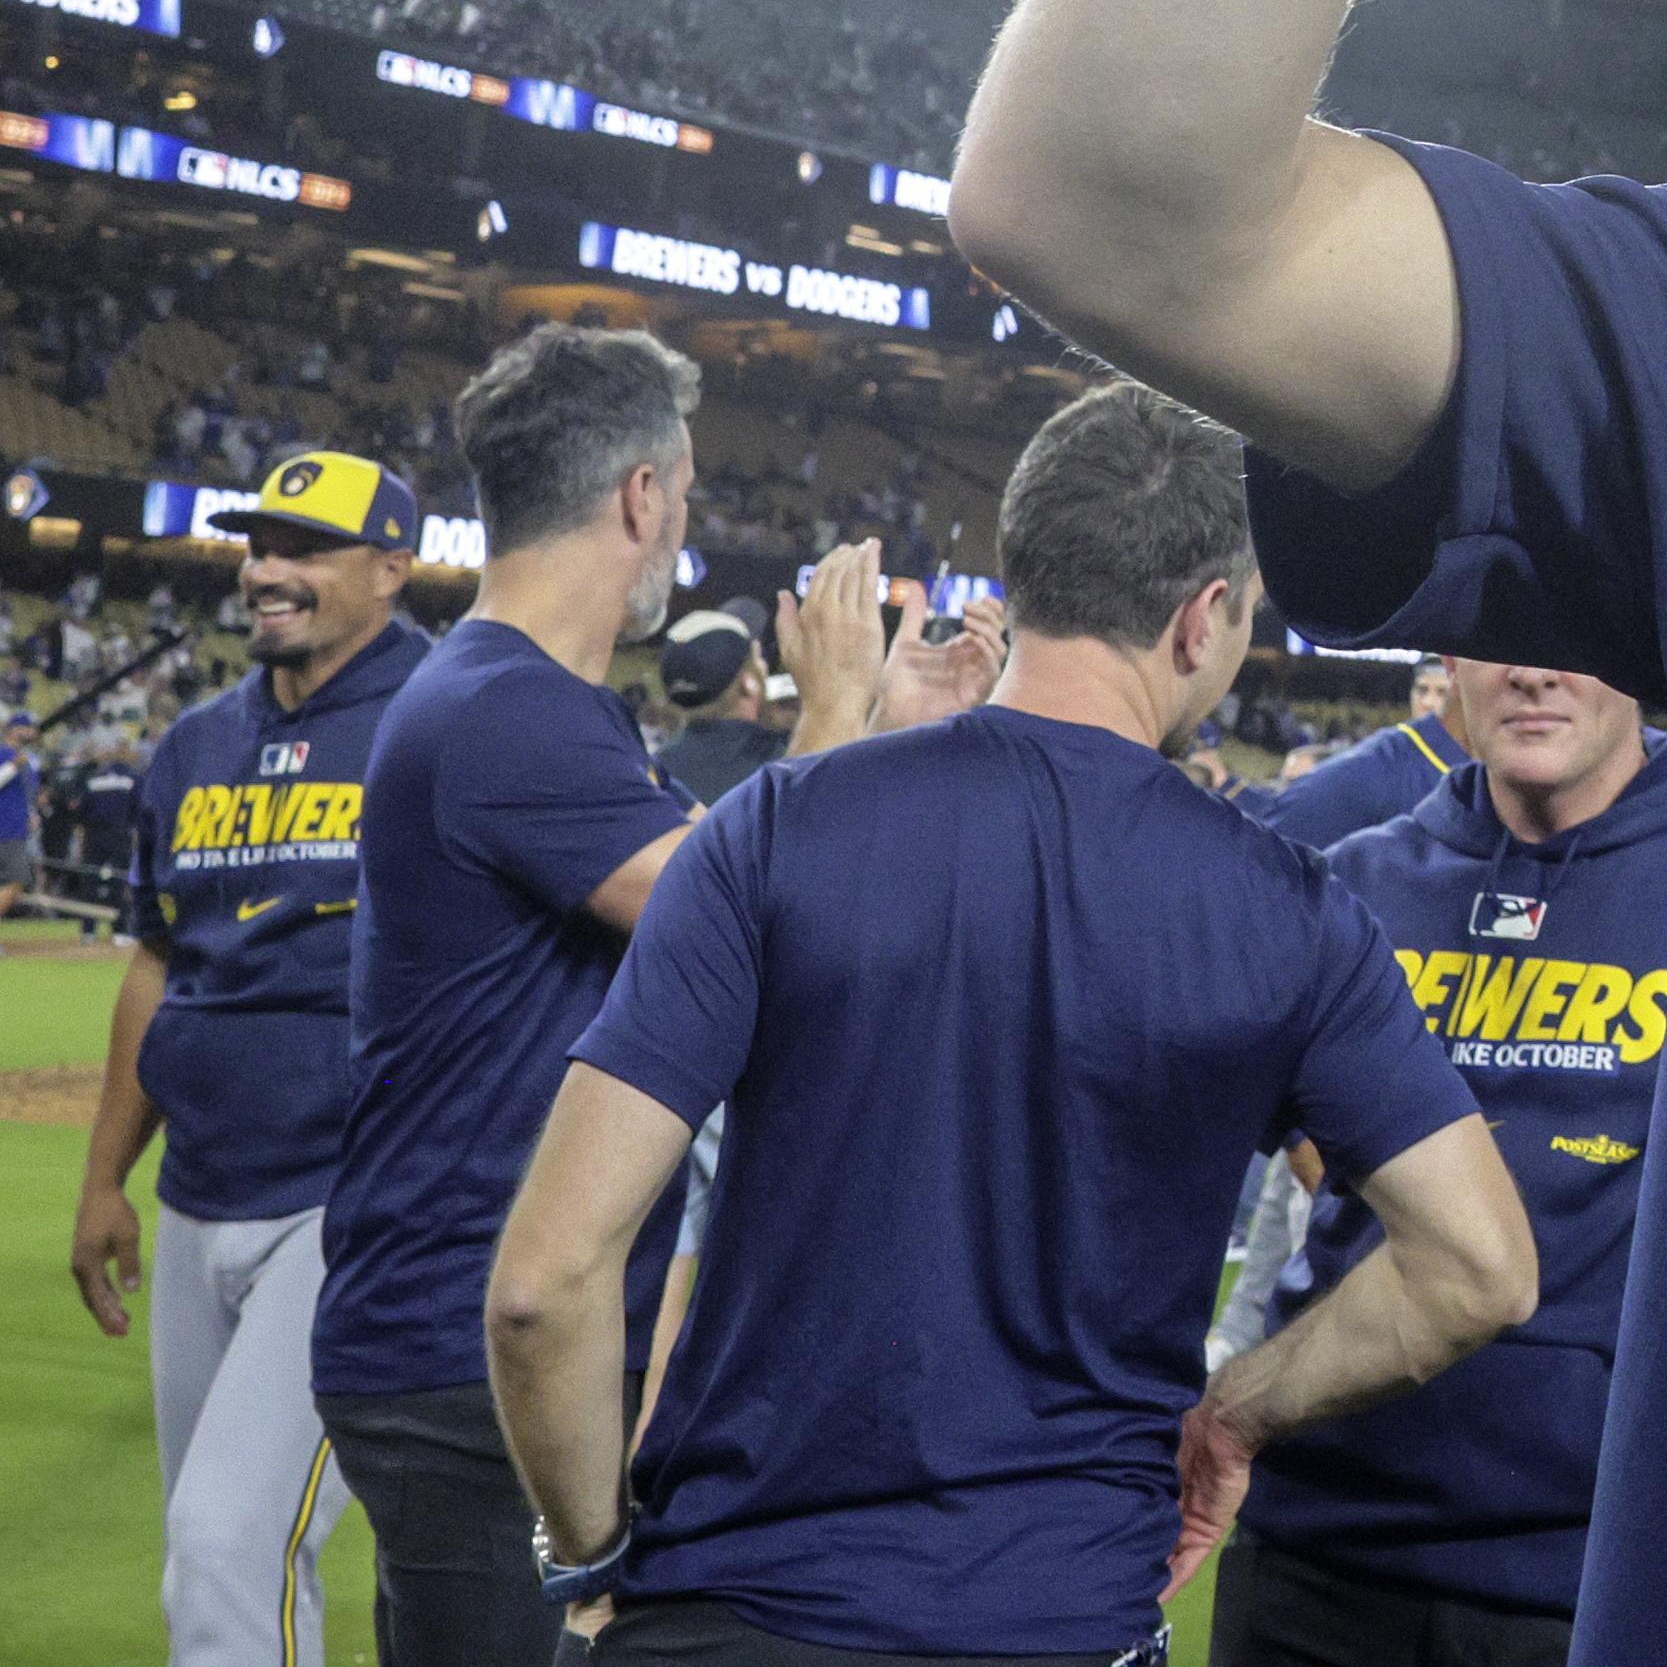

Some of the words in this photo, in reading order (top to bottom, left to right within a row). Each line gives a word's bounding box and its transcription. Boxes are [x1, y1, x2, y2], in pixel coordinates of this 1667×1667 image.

[227, 157, 300, 201] NLCS
[612, 227, 741, 294] BREWERS
[787, 264, 901, 326] DODGERS
[170, 783, 364, 852] BREWER
[1452, 1042, 1492, 1066] IKE
[1495, 1044, 1614, 1071] OCTOBER
